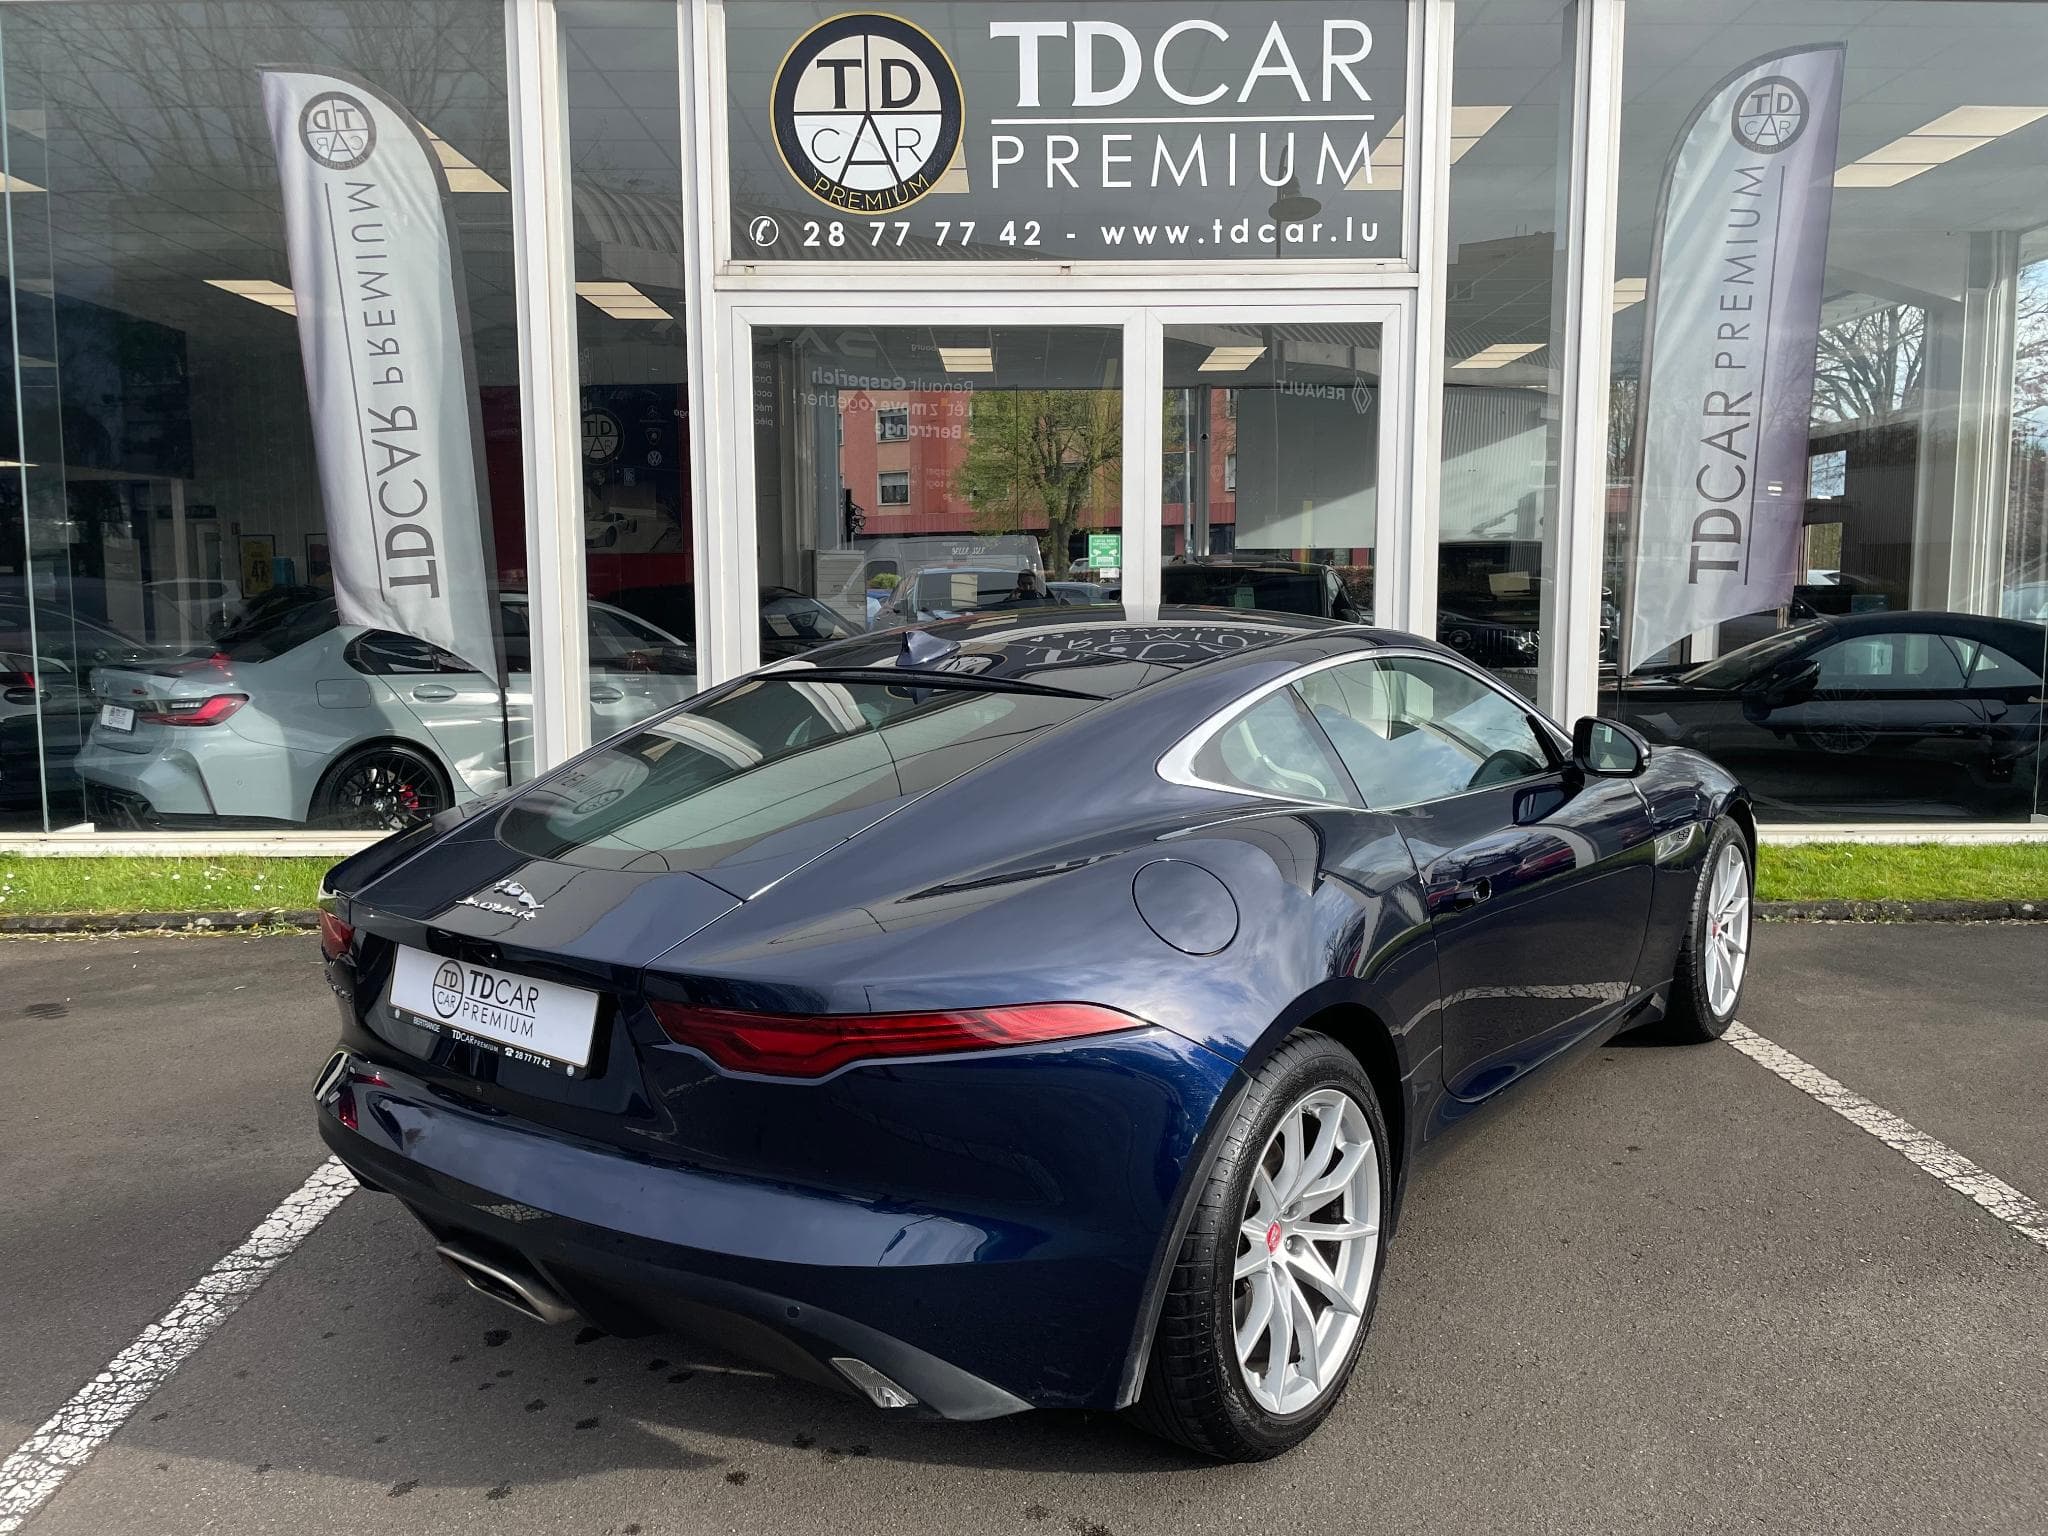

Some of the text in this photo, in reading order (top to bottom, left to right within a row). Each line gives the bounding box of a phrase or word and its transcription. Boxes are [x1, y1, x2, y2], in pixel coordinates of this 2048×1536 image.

[816, 59, 921, 109] TD
[990, 19, 1373, 107] TDCAR
[811, 113, 922, 185] CAR
[991, 131, 1373, 188] PREMIUM
[813, 173, 930, 210] PREMIUM
[803, 221, 845, 247] 28
[869, 221, 910, 247] 77
[935, 221, 977, 247] 77
[999, 220, 1041, 246] 42
[1100, 216, 1379, 245] www.tdcar.lu
[1688, 165, 1764, 585] TDCAR PREMIUM
[437, 991, 456, 1008] CAR
[443, 969, 458, 988] TD
[469, 969, 539, 1013] TDCAR
[462, 1002, 534, 1038] PREMIUM
